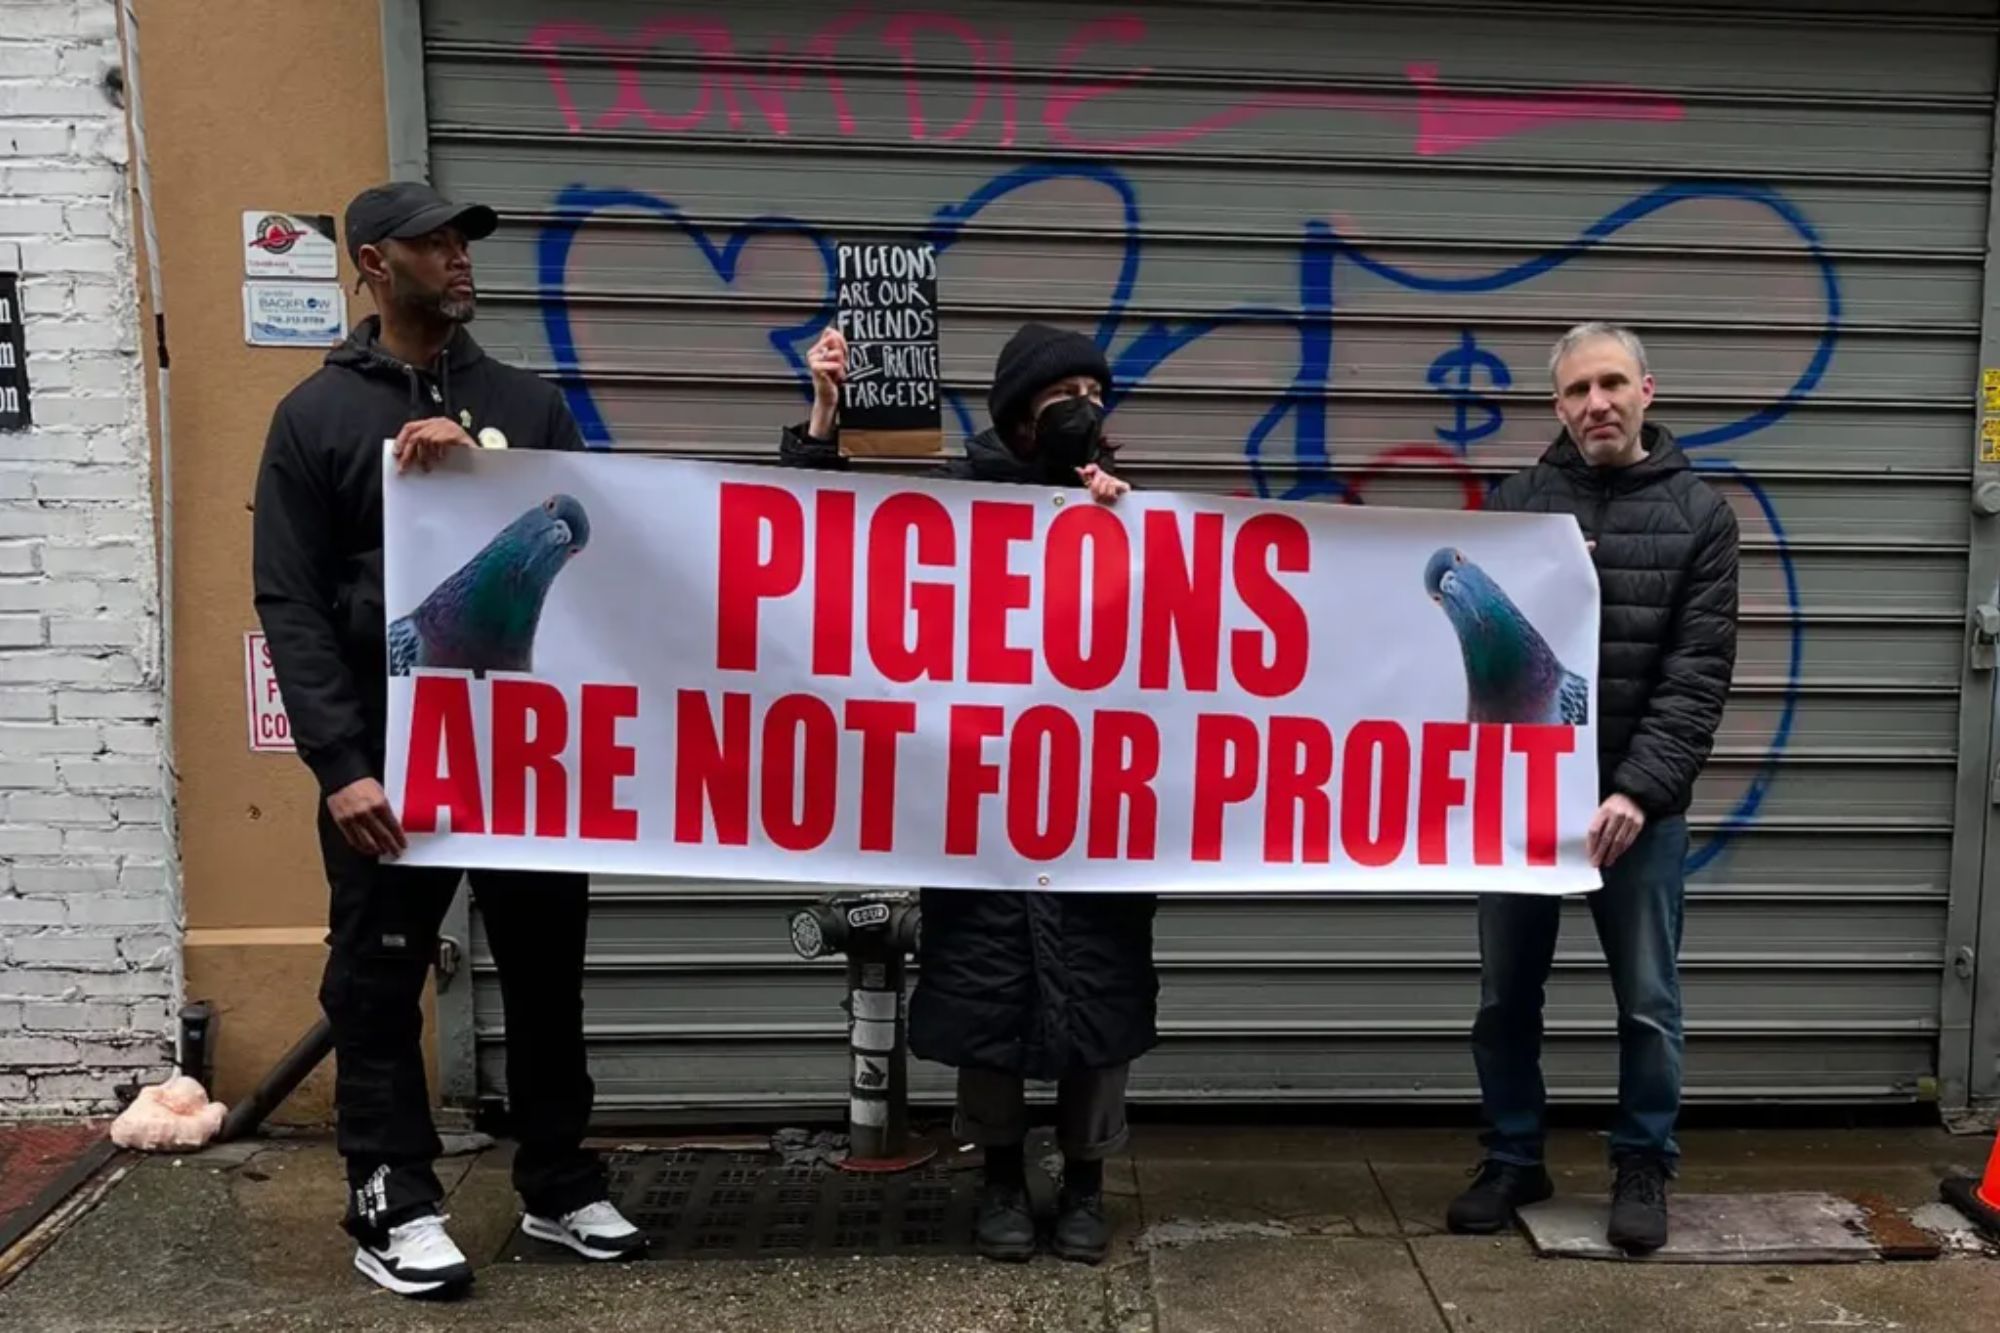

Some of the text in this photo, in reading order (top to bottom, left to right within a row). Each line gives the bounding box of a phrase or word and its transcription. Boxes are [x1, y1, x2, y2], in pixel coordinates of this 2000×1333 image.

[838, 245, 937, 280] PIGEONS
[838, 280, 930, 307] ARE OUR
[837, 308, 935, 340] FRIENDS
[882, 345, 938, 380] PRACTICE
[844, 380, 937, 411] TARGETS!
[717, 481, 1311, 698] PIGEONS
[401, 675, 1576, 866] ARE NOT FOR PROFIT
